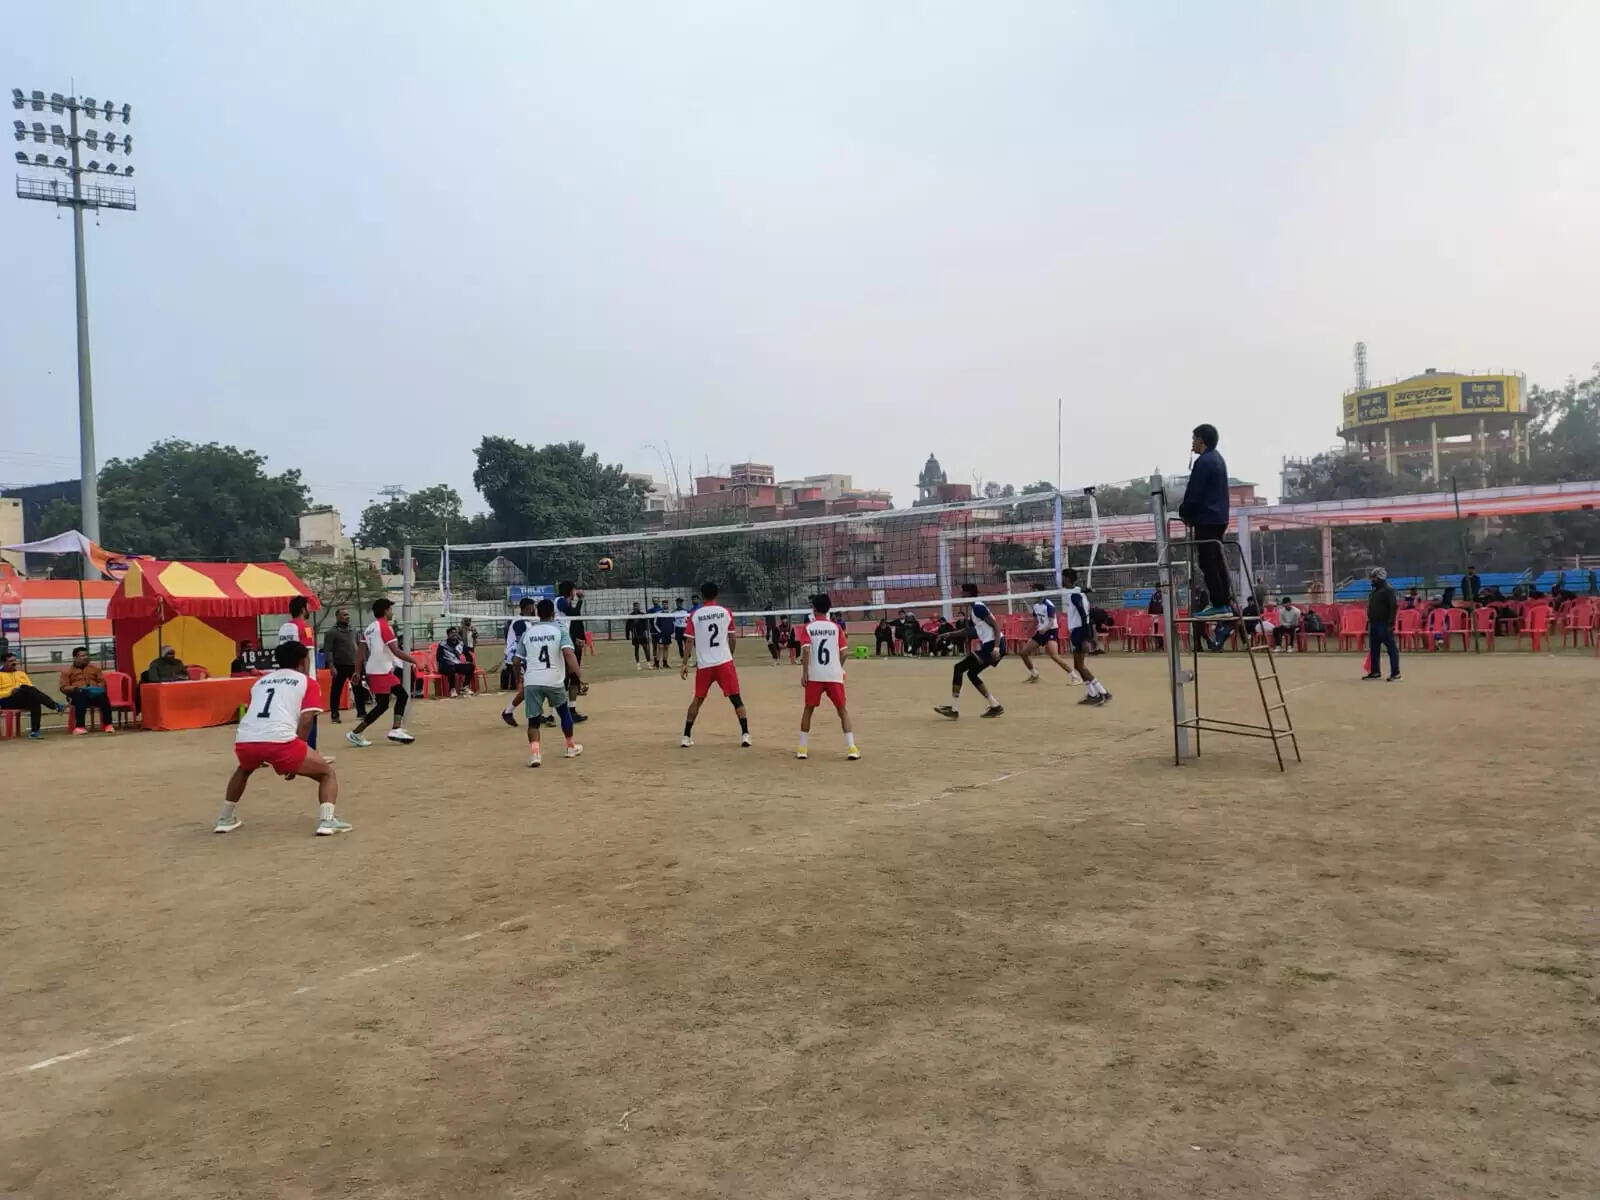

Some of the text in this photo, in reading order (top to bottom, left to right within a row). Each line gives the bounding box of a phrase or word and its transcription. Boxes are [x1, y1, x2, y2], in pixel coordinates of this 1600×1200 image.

[698, 613, 724, 621] MANIPUR
[708, 623, 719, 647] 2
[242, 651, 256, 663] 18
[538, 645, 551, 668] 4
[818, 639, 830, 665] 6
[260, 678, 299, 687] MANIPUR
[257, 688, 275, 718] 1
